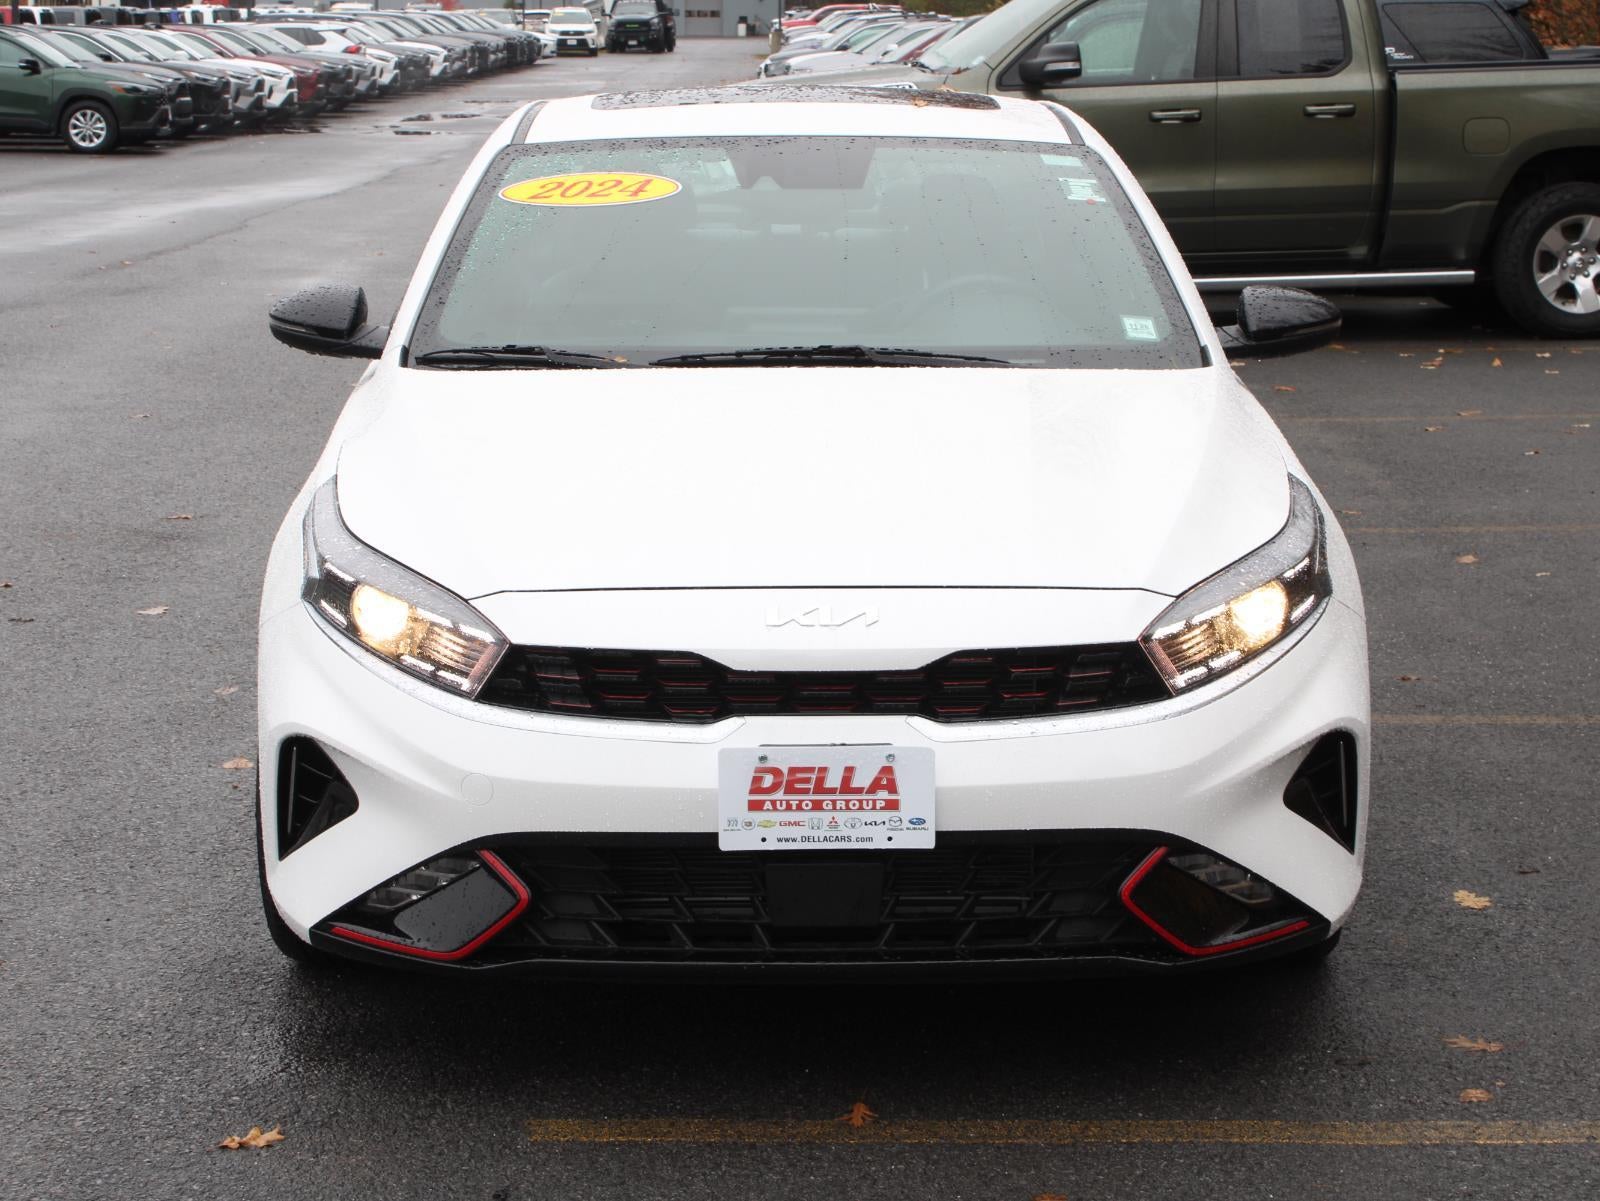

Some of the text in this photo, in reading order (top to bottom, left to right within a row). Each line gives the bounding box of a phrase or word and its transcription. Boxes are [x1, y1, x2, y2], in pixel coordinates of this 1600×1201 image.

[527, 178, 653, 200] 2024
[748, 765, 900, 796] DELLA
[762, 800, 887, 810] AUTO GROUP
[776, 835, 874, 844] www.DELLACARS.com
